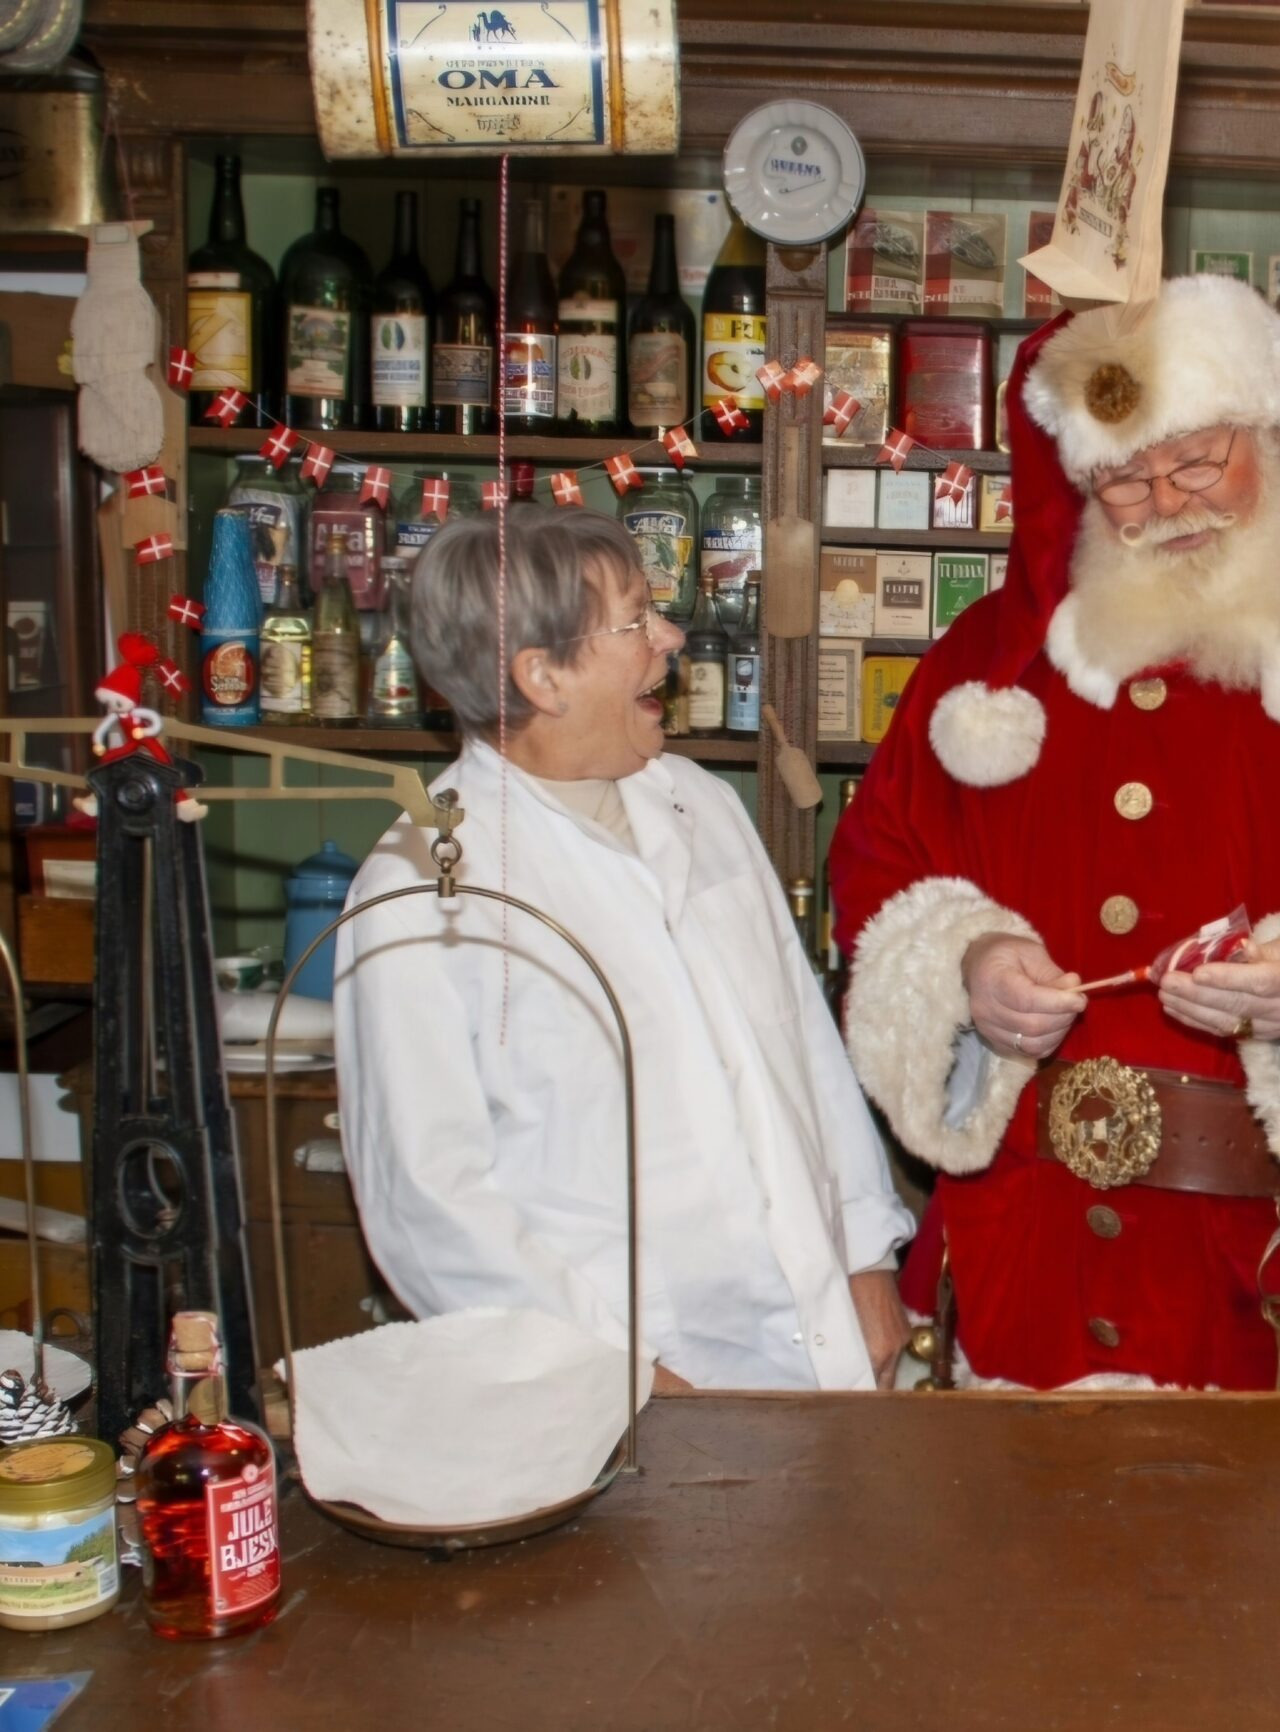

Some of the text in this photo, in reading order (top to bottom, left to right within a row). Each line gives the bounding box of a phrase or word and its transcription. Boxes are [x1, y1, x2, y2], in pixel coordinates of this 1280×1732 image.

[438, 69, 560, 90] OMA
[446, 95, 551, 107] MARGARINE
[227, 1497, 274, 1542] JULE
